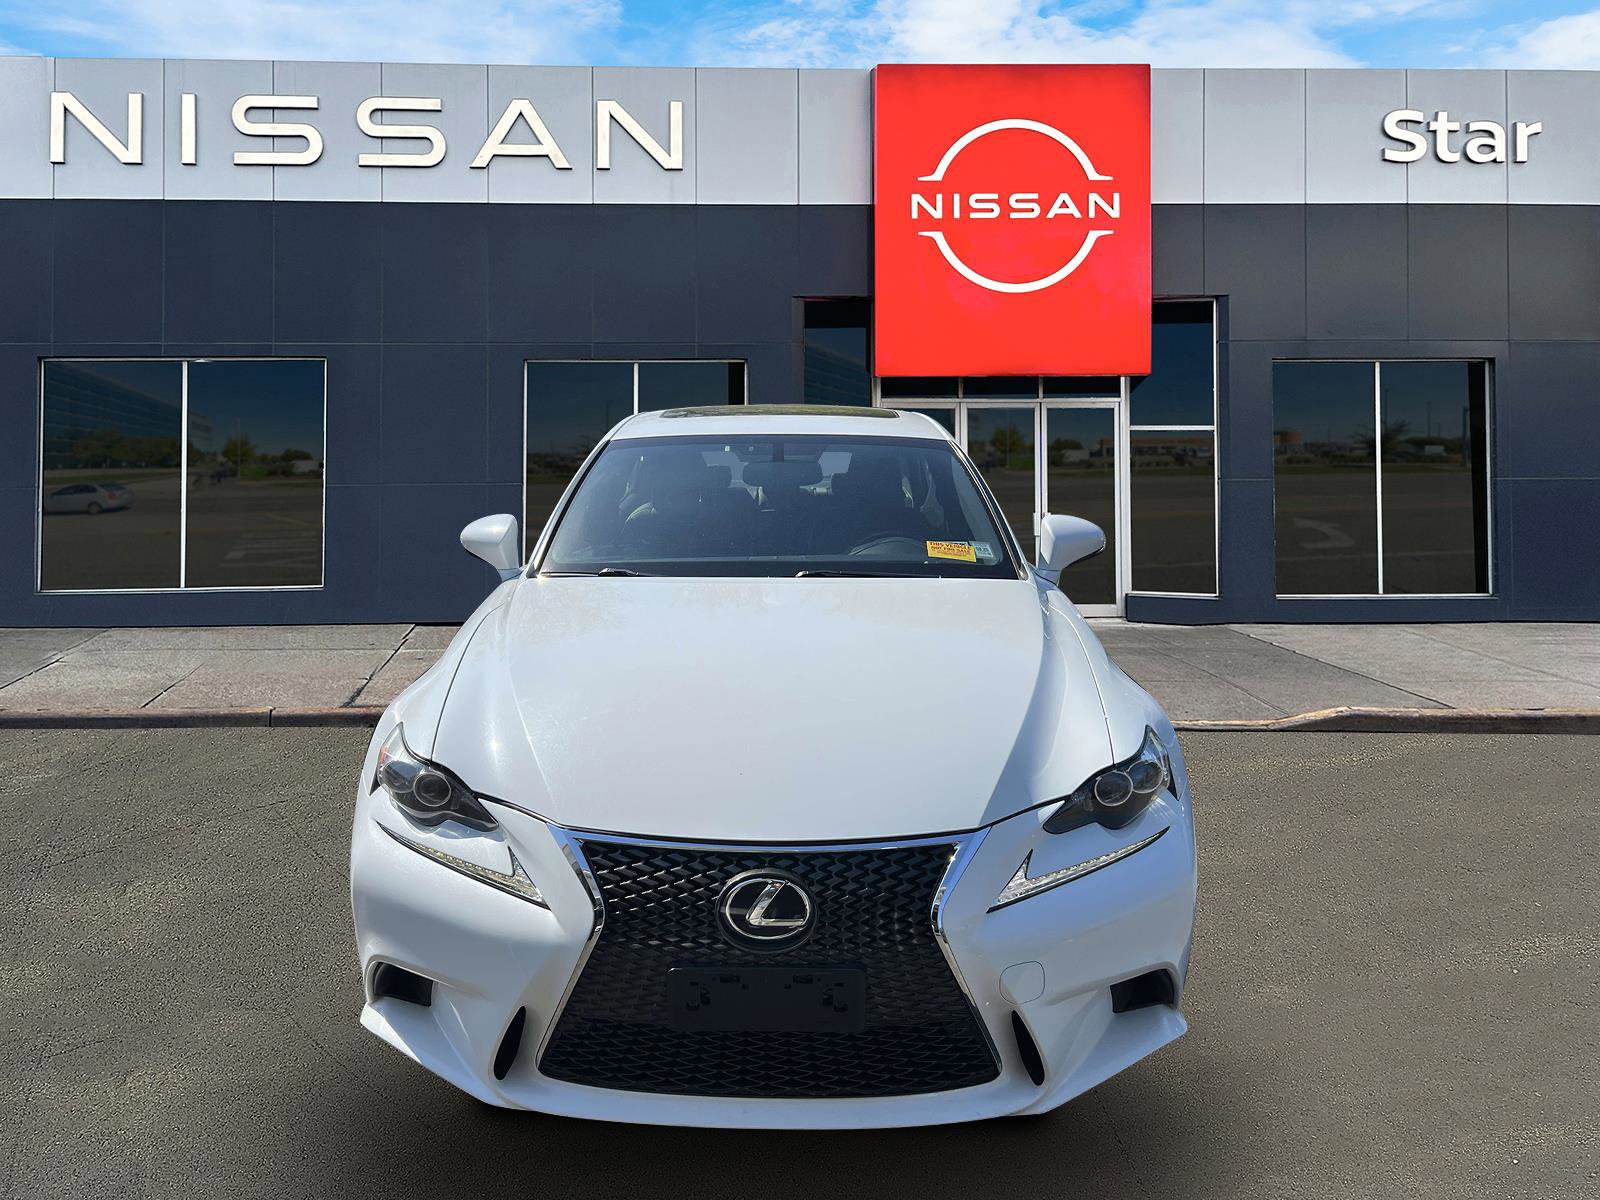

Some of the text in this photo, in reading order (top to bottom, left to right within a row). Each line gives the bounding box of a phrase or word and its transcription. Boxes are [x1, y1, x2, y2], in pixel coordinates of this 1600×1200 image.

[49, 91, 684, 171] NISSAN
[1381, 109, 1543, 164] Star
[910, 191, 1121, 219] NISSAN
